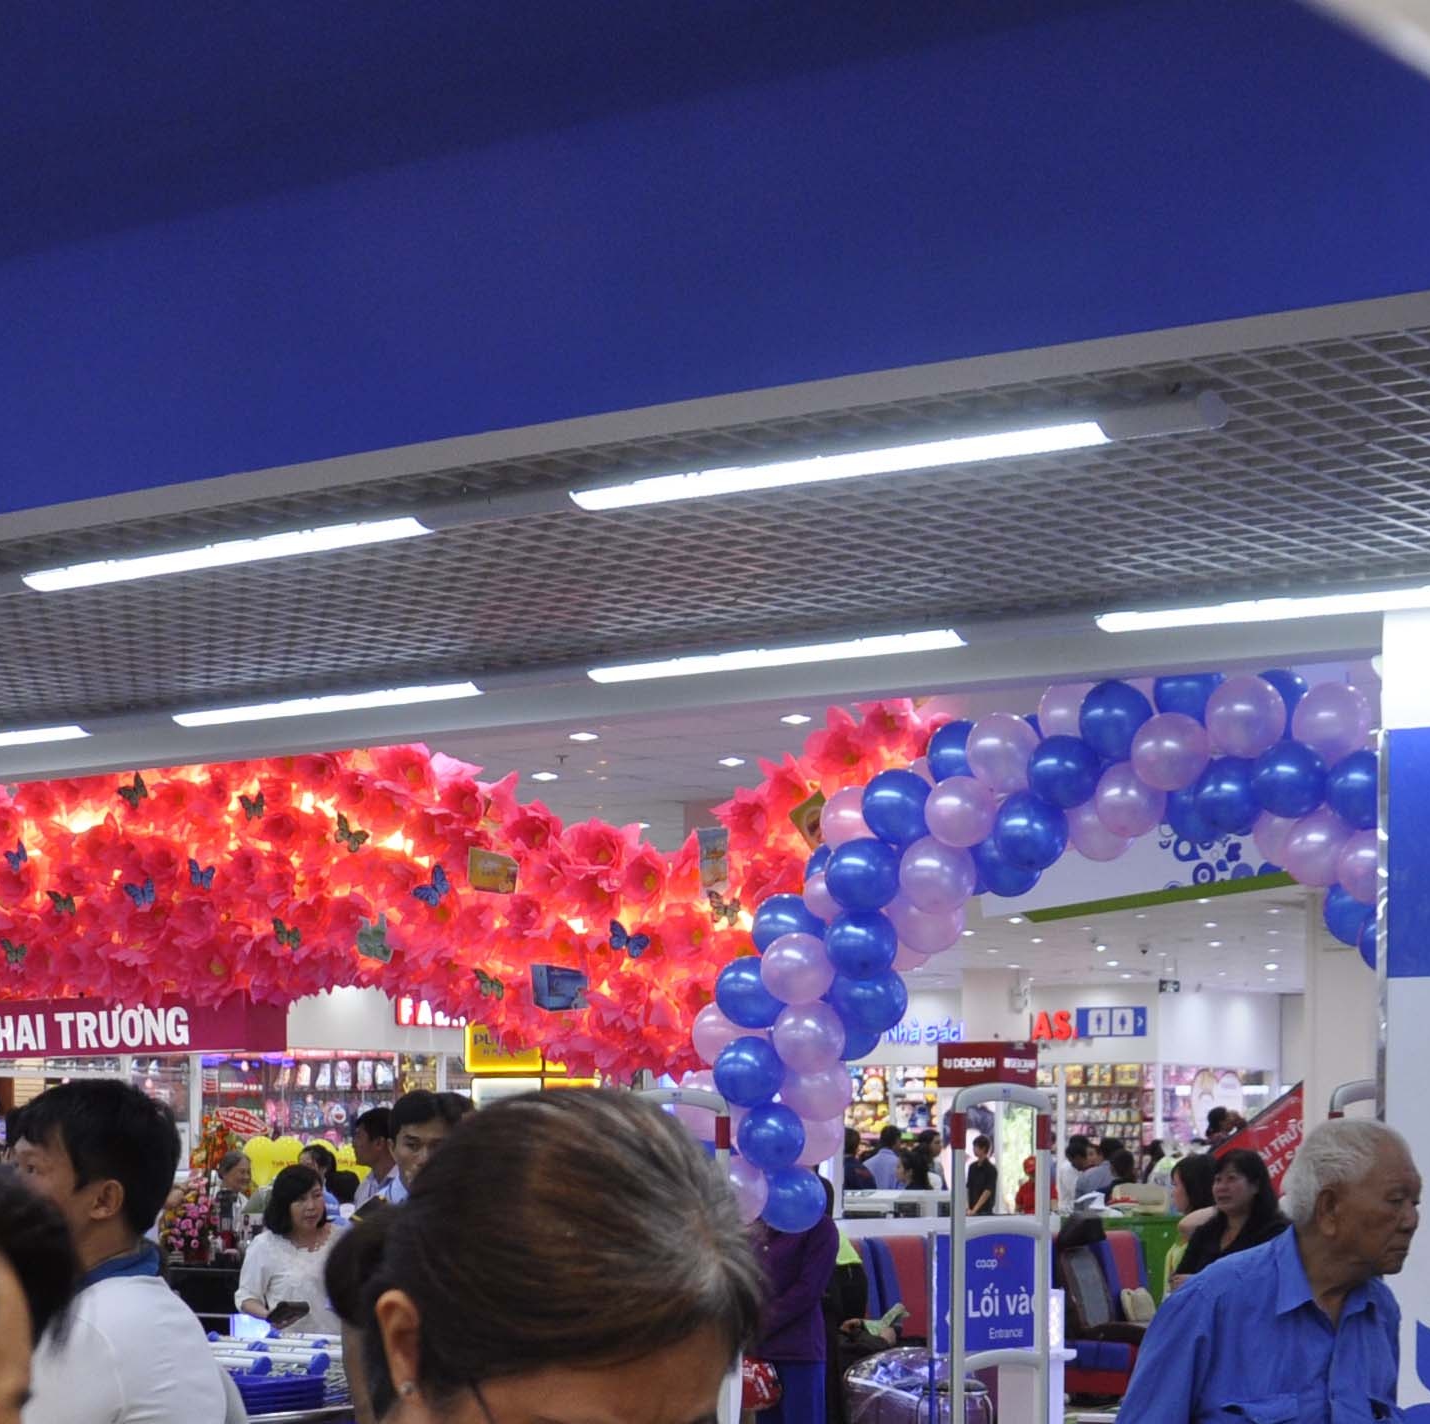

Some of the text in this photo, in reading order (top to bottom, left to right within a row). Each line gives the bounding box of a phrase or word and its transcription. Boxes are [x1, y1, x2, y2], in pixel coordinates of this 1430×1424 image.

[54, 1003, 190, 1050] TRƯƠNG
[1031, 1010, 1079, 1041] AS
[968, 1283, 999, 1318] Lối
[989, 1328, 1023, 1339] Entrance
